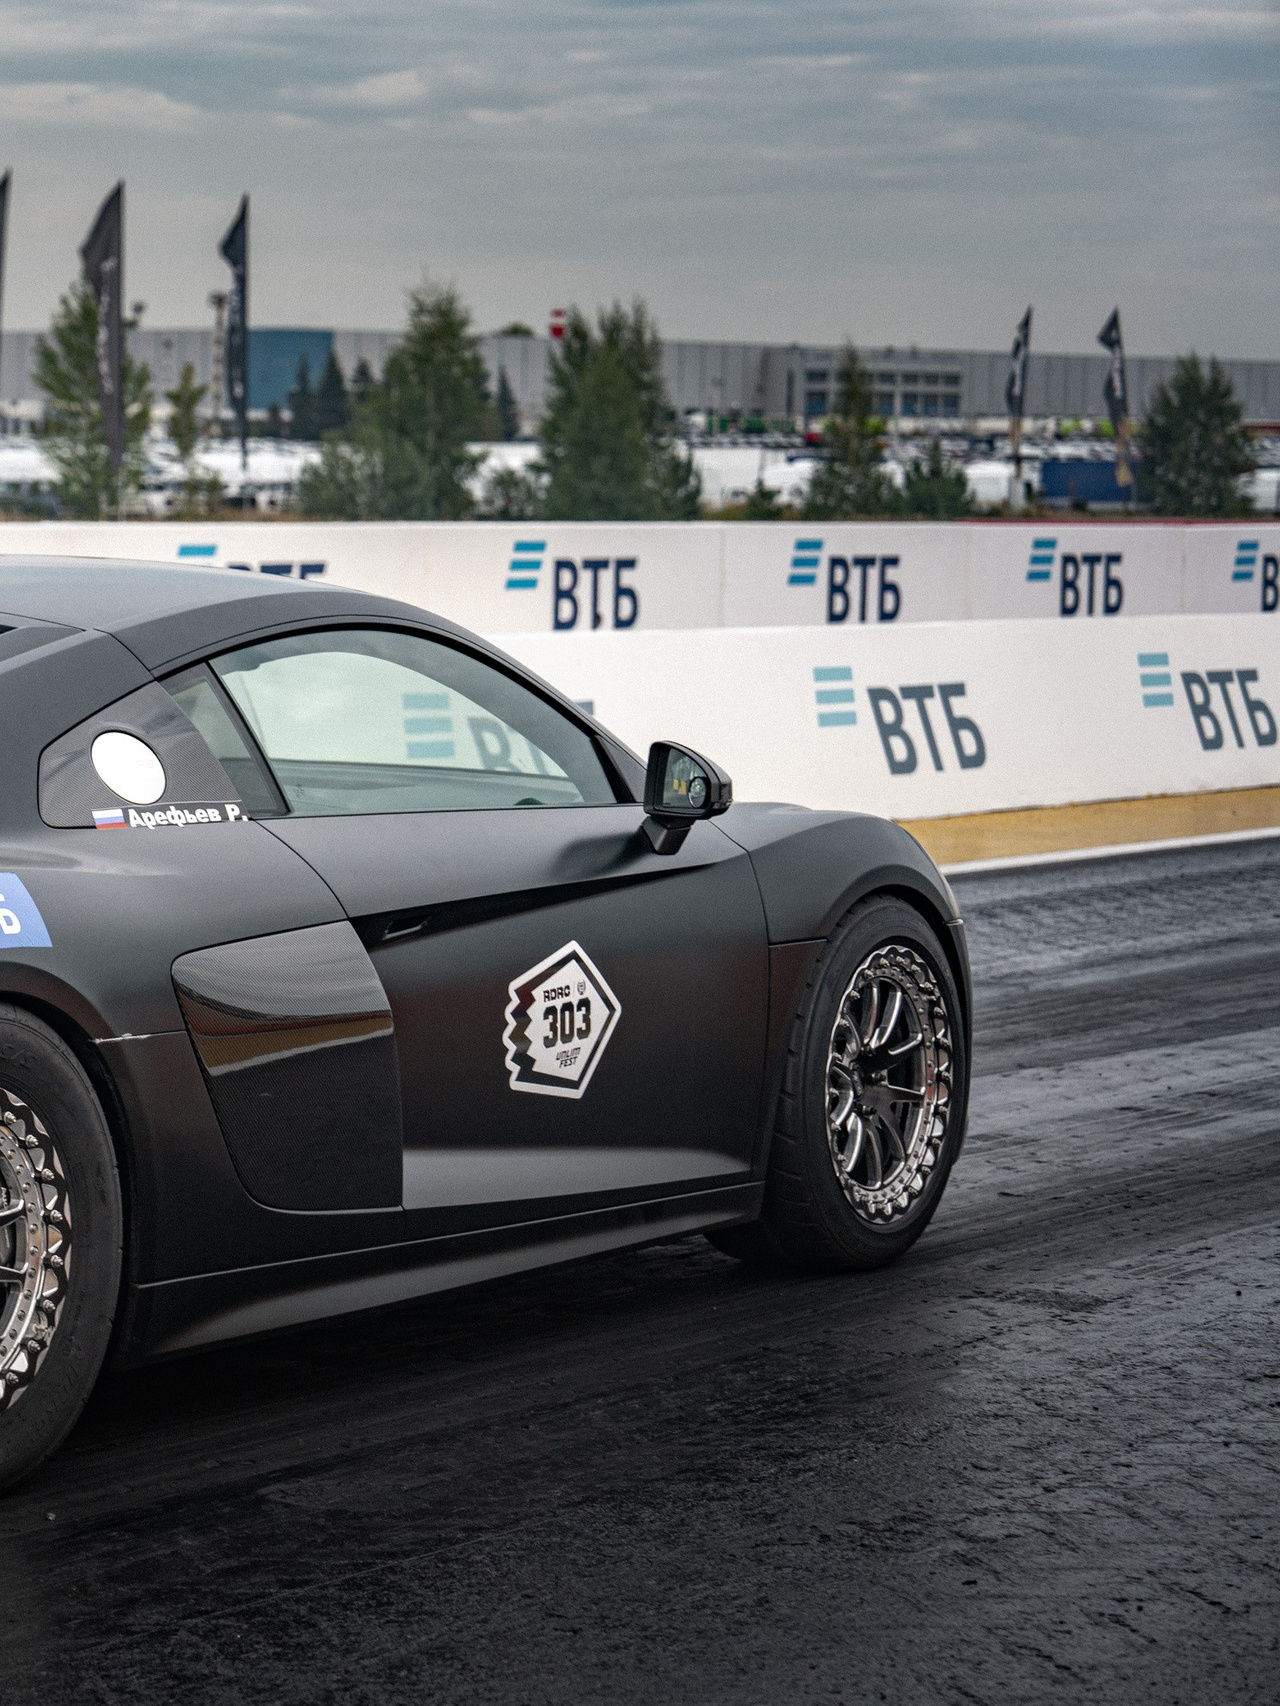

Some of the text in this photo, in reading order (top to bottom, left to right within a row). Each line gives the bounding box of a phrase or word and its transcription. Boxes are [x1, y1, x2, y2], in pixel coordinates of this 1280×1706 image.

[552, 557, 638, 631] ВТБ
[827, 556, 901, 623] ВТБ
[1059, 553, 1123, 617] ВТБ
[867, 682, 986, 775] ВТБ
[1180, 669, 1278, 751] ВТБ
[128, 805, 222, 830] Арефьев
[543, 985, 571, 1003] RDRC
[543, 997, 591, 1049] 303
[559, 1056, 578, 1068] FEST
